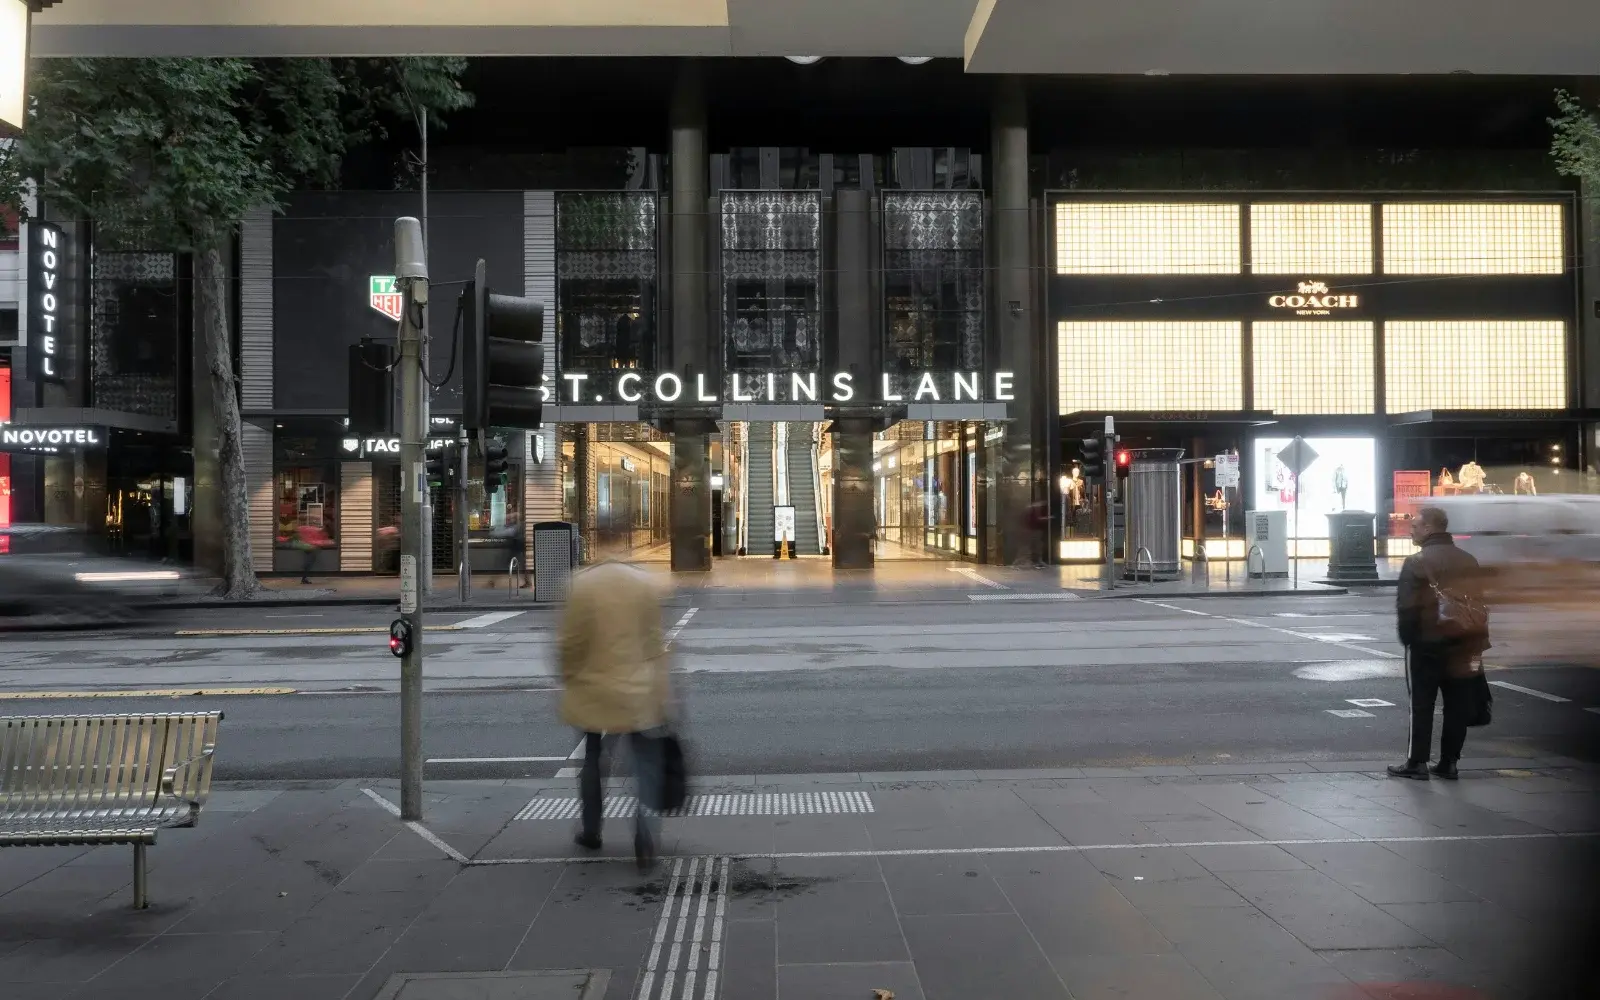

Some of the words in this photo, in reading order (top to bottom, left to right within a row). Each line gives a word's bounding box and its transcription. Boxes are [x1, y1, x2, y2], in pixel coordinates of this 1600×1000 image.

[43, 228, 56, 375] NOVOTEL
[373, 295, 402, 315] HEU
[1269, 295, 1358, 308] COACH
[882, 371, 1015, 401] LANE
[3, 429, 98, 443] NOVOTEL
[366, 439, 400, 452] TAG
